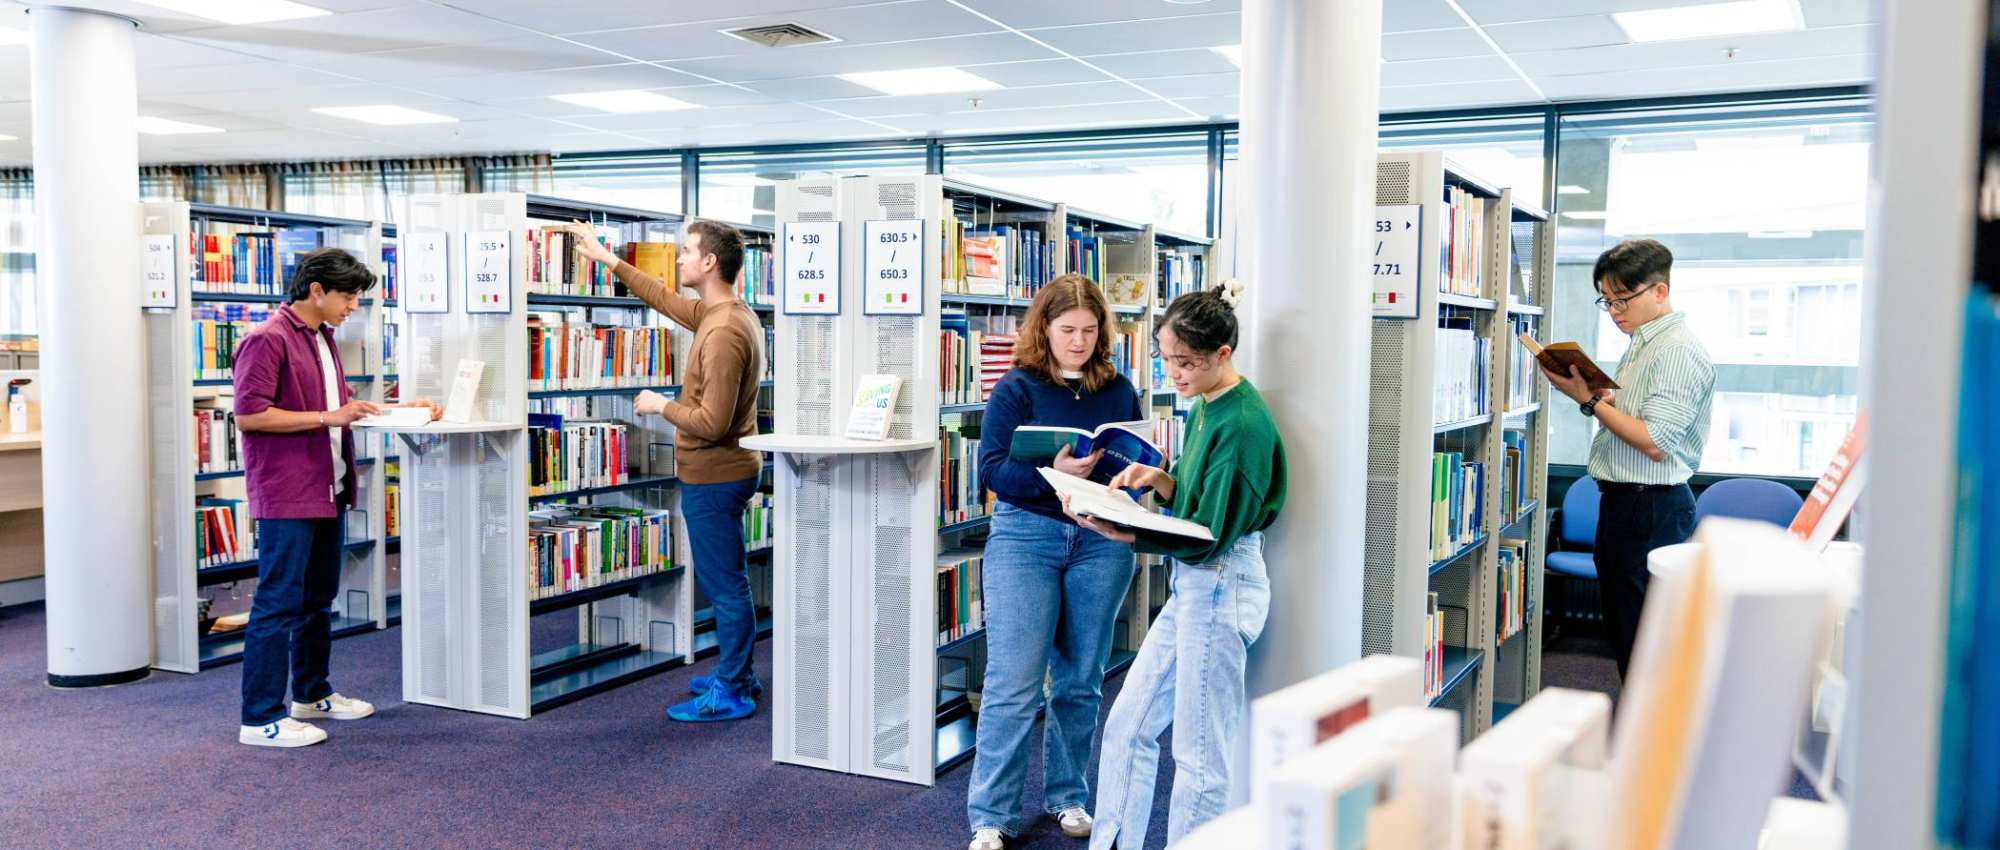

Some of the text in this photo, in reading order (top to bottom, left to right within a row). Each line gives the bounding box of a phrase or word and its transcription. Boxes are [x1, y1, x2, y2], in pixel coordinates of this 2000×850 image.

[1375, 220, 1392, 232] 53
[802, 234, 820, 244] 530
[880, 232, 908, 243] 630.5
[1375, 240, 1383, 256] /
[808, 251, 814, 263] /
[890, 250, 896, 262] /
[880, 269, 908, 279] 650.3
[1373, 263, 1401, 275] 7.71
[476, 273, 498, 282] 528.7
[798, 270, 825, 280] 628.5
[876, 398, 889, 408] US
